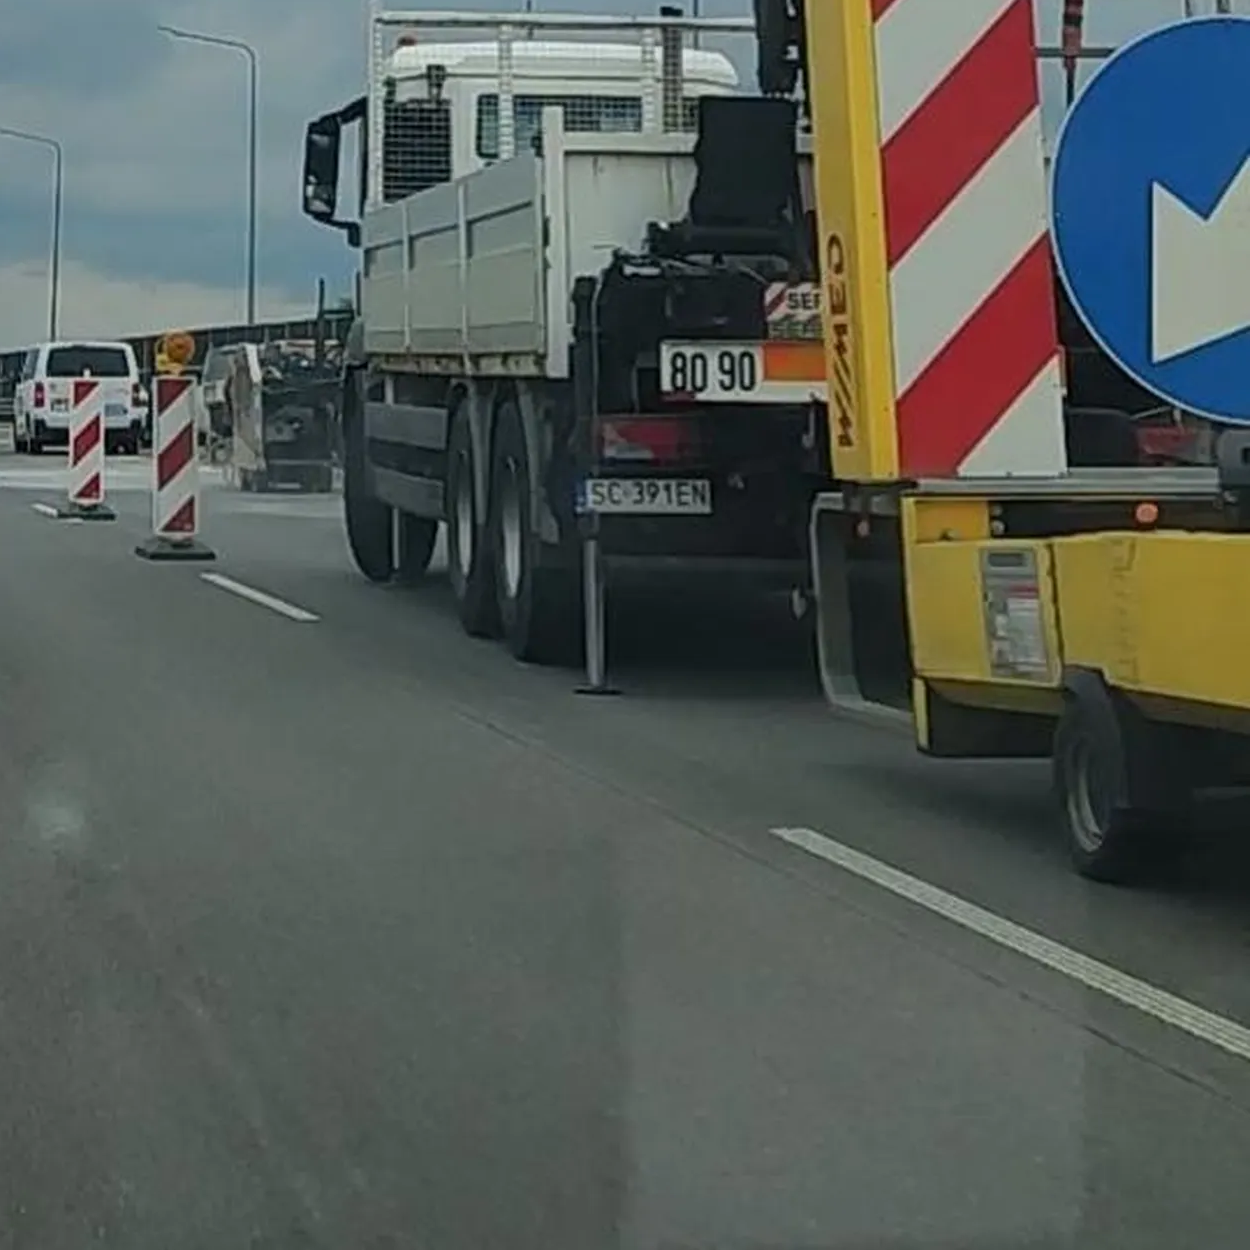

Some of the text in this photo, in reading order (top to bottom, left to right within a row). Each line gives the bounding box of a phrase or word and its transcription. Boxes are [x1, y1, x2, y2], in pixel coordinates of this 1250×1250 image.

[671, 351, 755, 391] 80 90
[592, 481, 706, 506] SC 391EN
